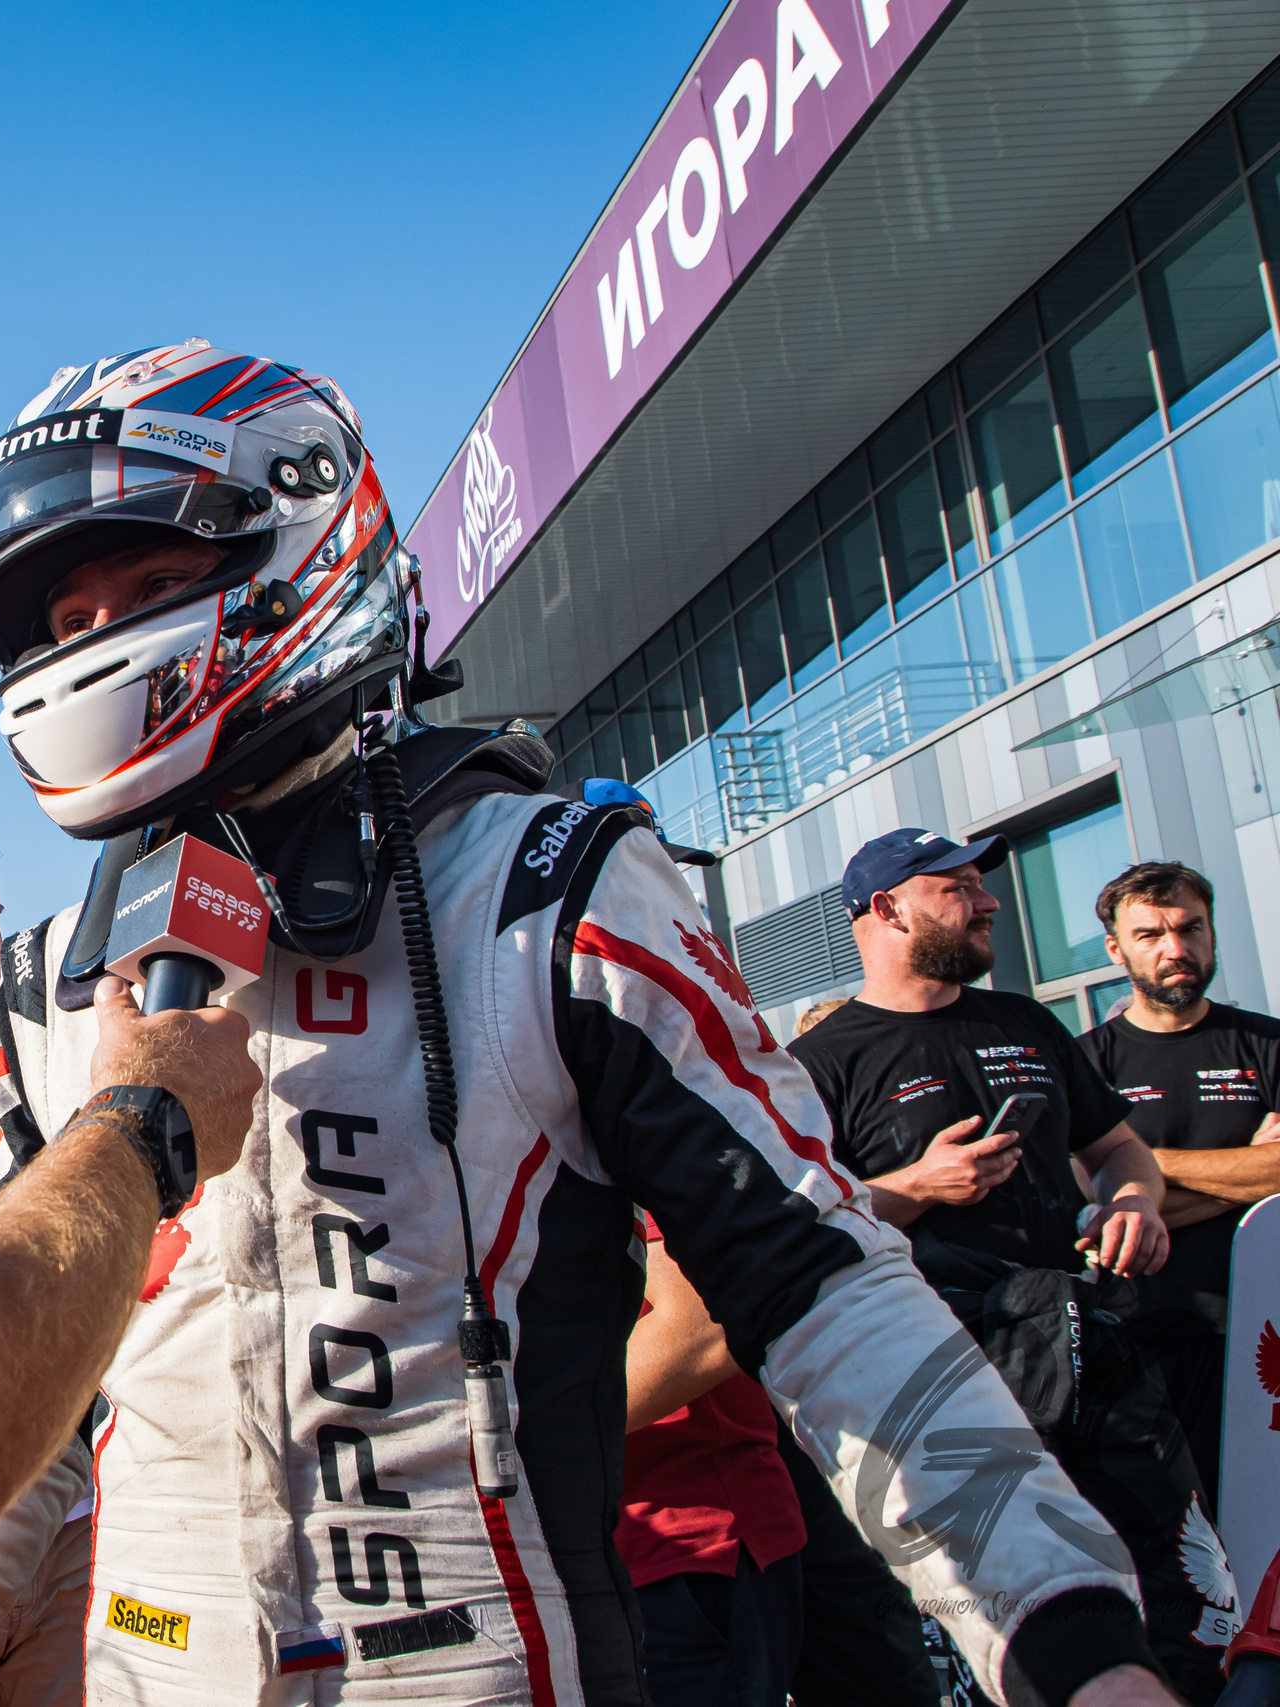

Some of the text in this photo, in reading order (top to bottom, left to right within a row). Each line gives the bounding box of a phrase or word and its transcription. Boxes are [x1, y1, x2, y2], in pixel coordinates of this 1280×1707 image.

[596, 0, 843, 379] ИГОРА
[148, 432, 203, 453] ASP TEAM
[494, 517, 522, 567] ДРАЙВ
[524, 801, 598, 878] Sabelt
[6, 924, 41, 986] abelt
[300, 1108, 428, 1610] SPORA
[113, 1598, 177, 1644] Sabelt
